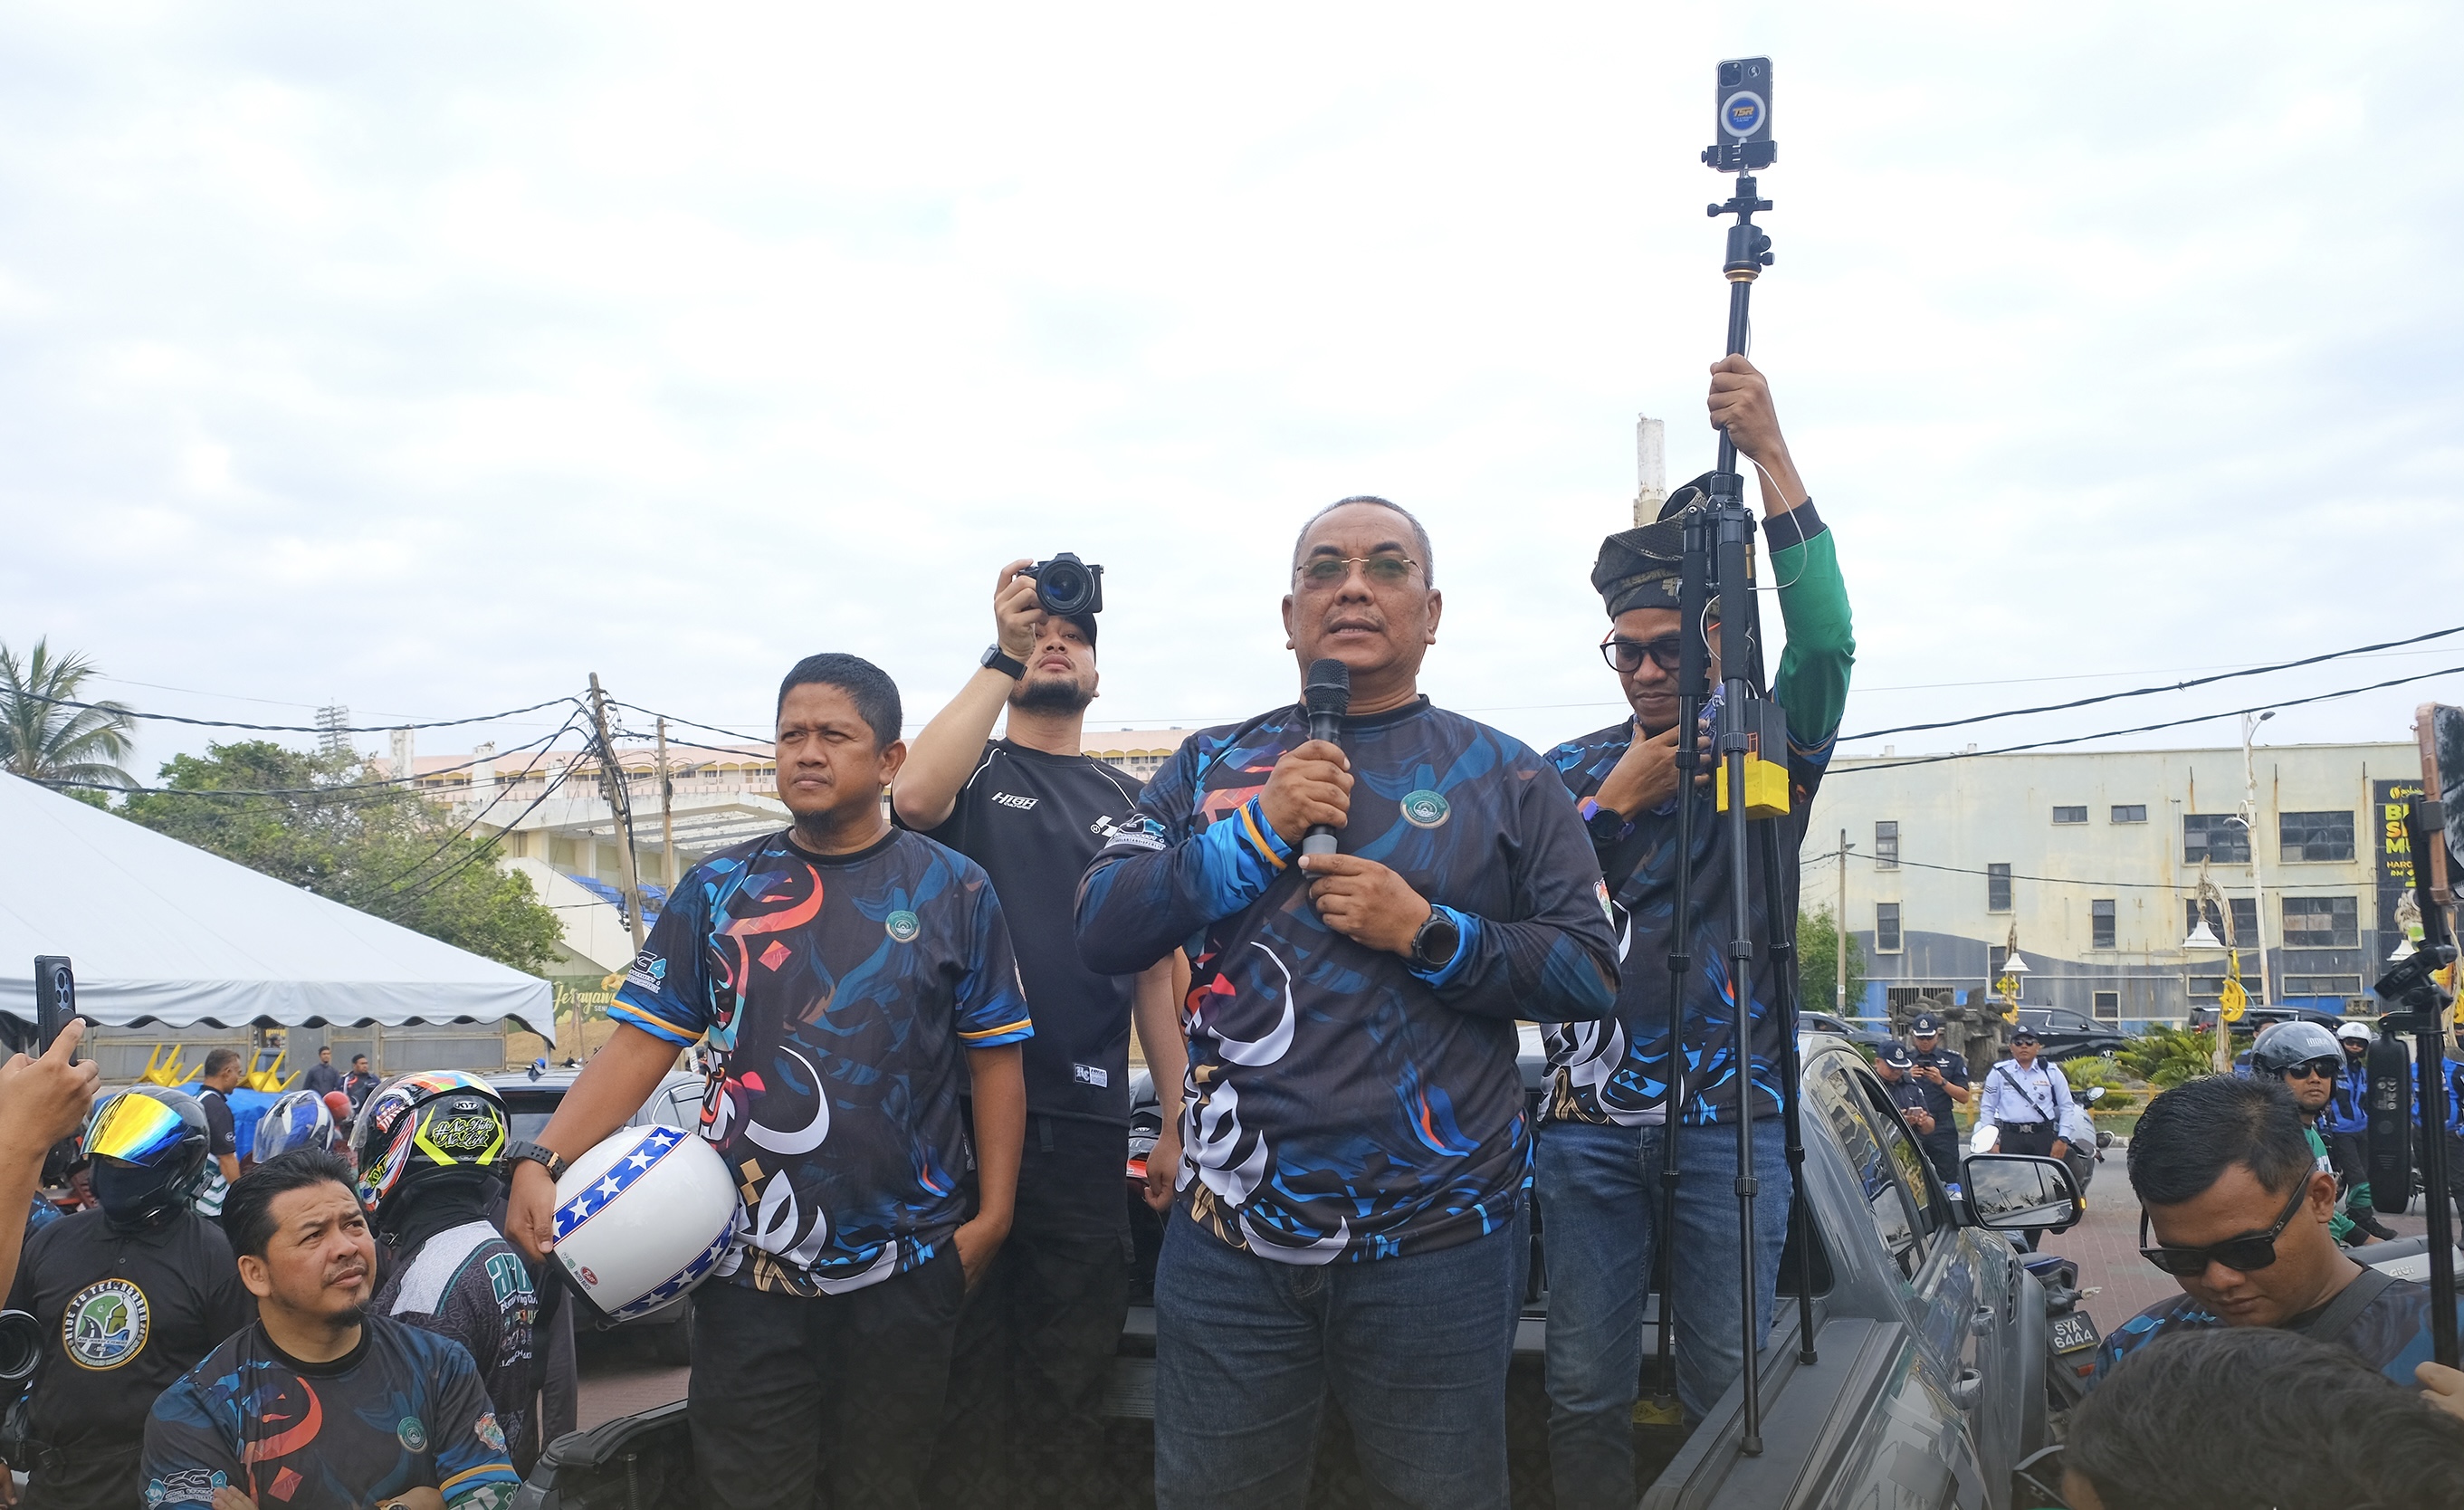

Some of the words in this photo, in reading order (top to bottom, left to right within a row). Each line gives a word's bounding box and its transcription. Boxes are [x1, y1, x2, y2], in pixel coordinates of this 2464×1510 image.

[991, 791, 1039, 808] HIGH
[65, 1311, 76, 1340] RIDE
[72, 1295, 88, 1308] TO
[2054, 1320, 2083, 1336] SYA
[2054, 1329, 2094, 1349] 6444
